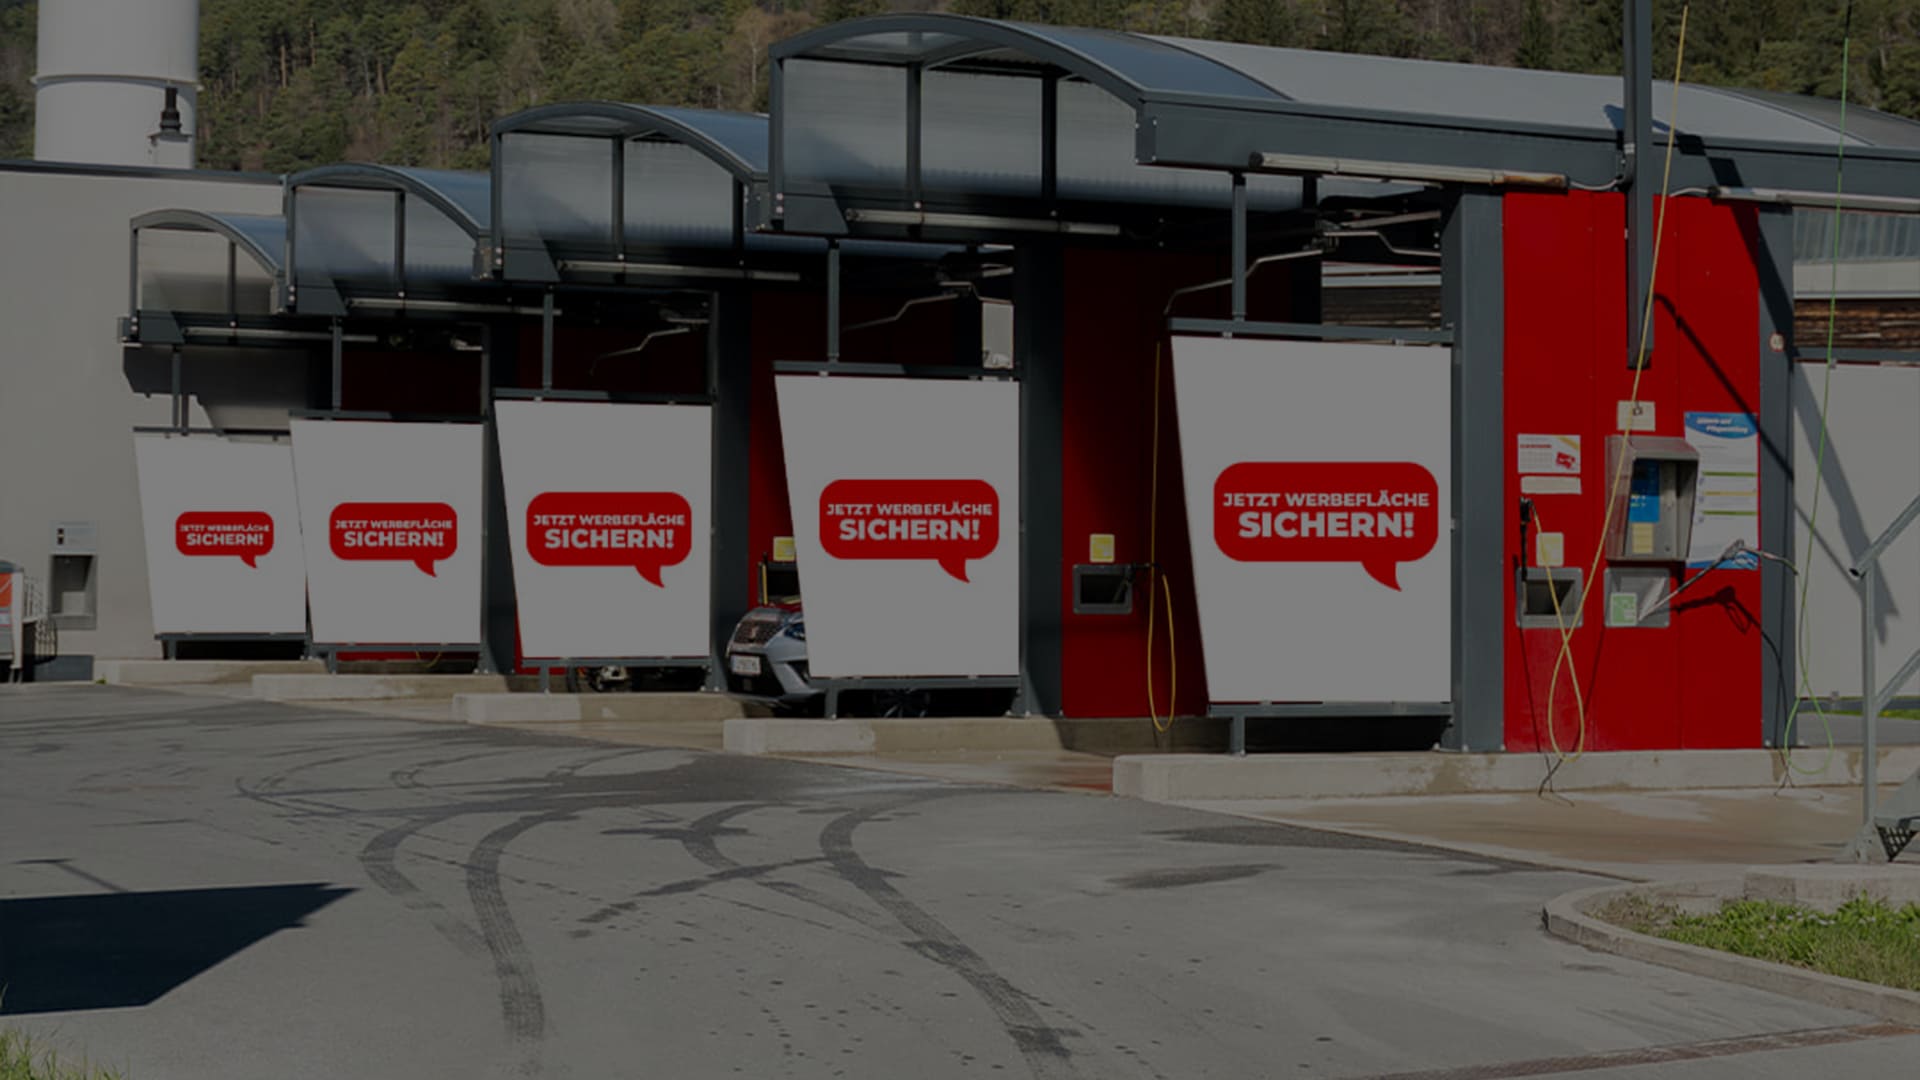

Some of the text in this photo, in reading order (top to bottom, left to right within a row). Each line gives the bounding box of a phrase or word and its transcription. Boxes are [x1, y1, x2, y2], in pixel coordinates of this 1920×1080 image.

[1222, 490, 1430, 507] JETZT WERBEFLÄCHE
[826, 502, 993, 515] JETZT WERBEFLÄCHE
[335, 519, 453, 529] JETZT WERBEFLÄCHE
[533, 513, 685, 525] JETZT WERBEFLÄCHE
[1238, 511, 1415, 538] SICHERN!
[839, 519, 981, 540] SICHERN!
[186, 533, 264, 545] SICHERN!
[343, 531, 445, 547] SICHERN!
[544, 528, 675, 548] SICHERN!
